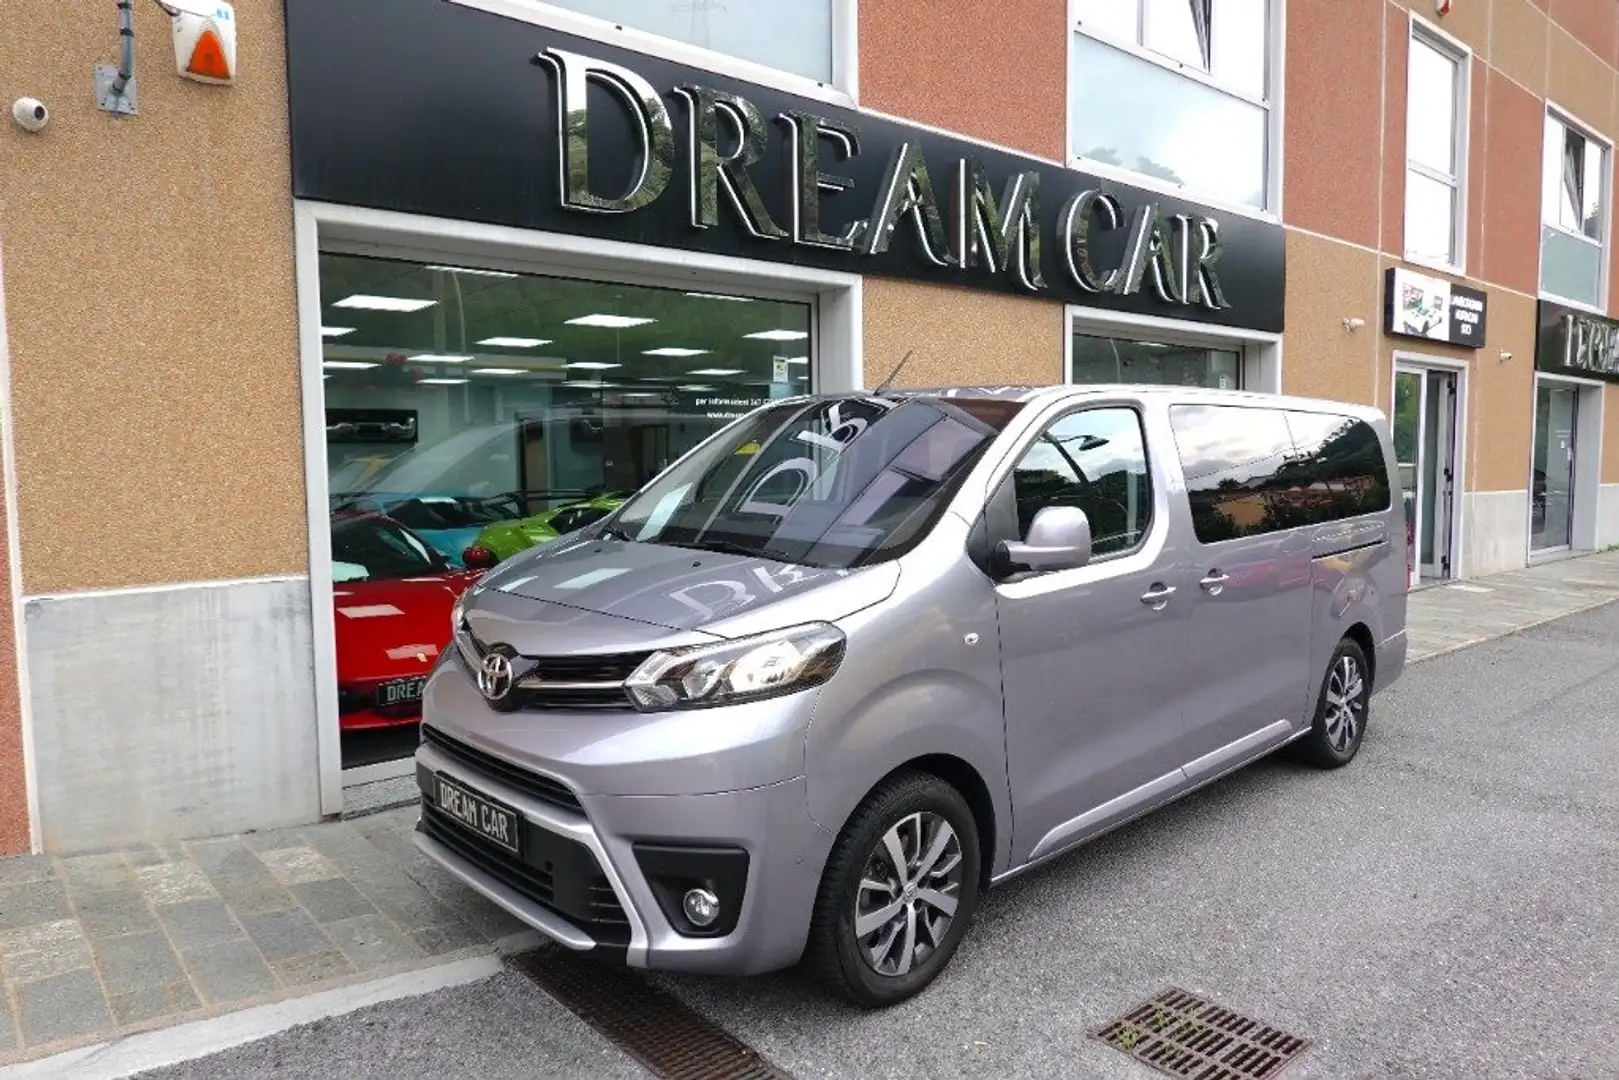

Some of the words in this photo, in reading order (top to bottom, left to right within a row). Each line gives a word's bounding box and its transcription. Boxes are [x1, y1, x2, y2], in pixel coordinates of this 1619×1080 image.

[536, 46, 1048, 292] DREAM
[1056, 188, 1231, 311] CAR
[441, 783, 478, 827] DREAM
[481, 804, 509, 843] CAR
